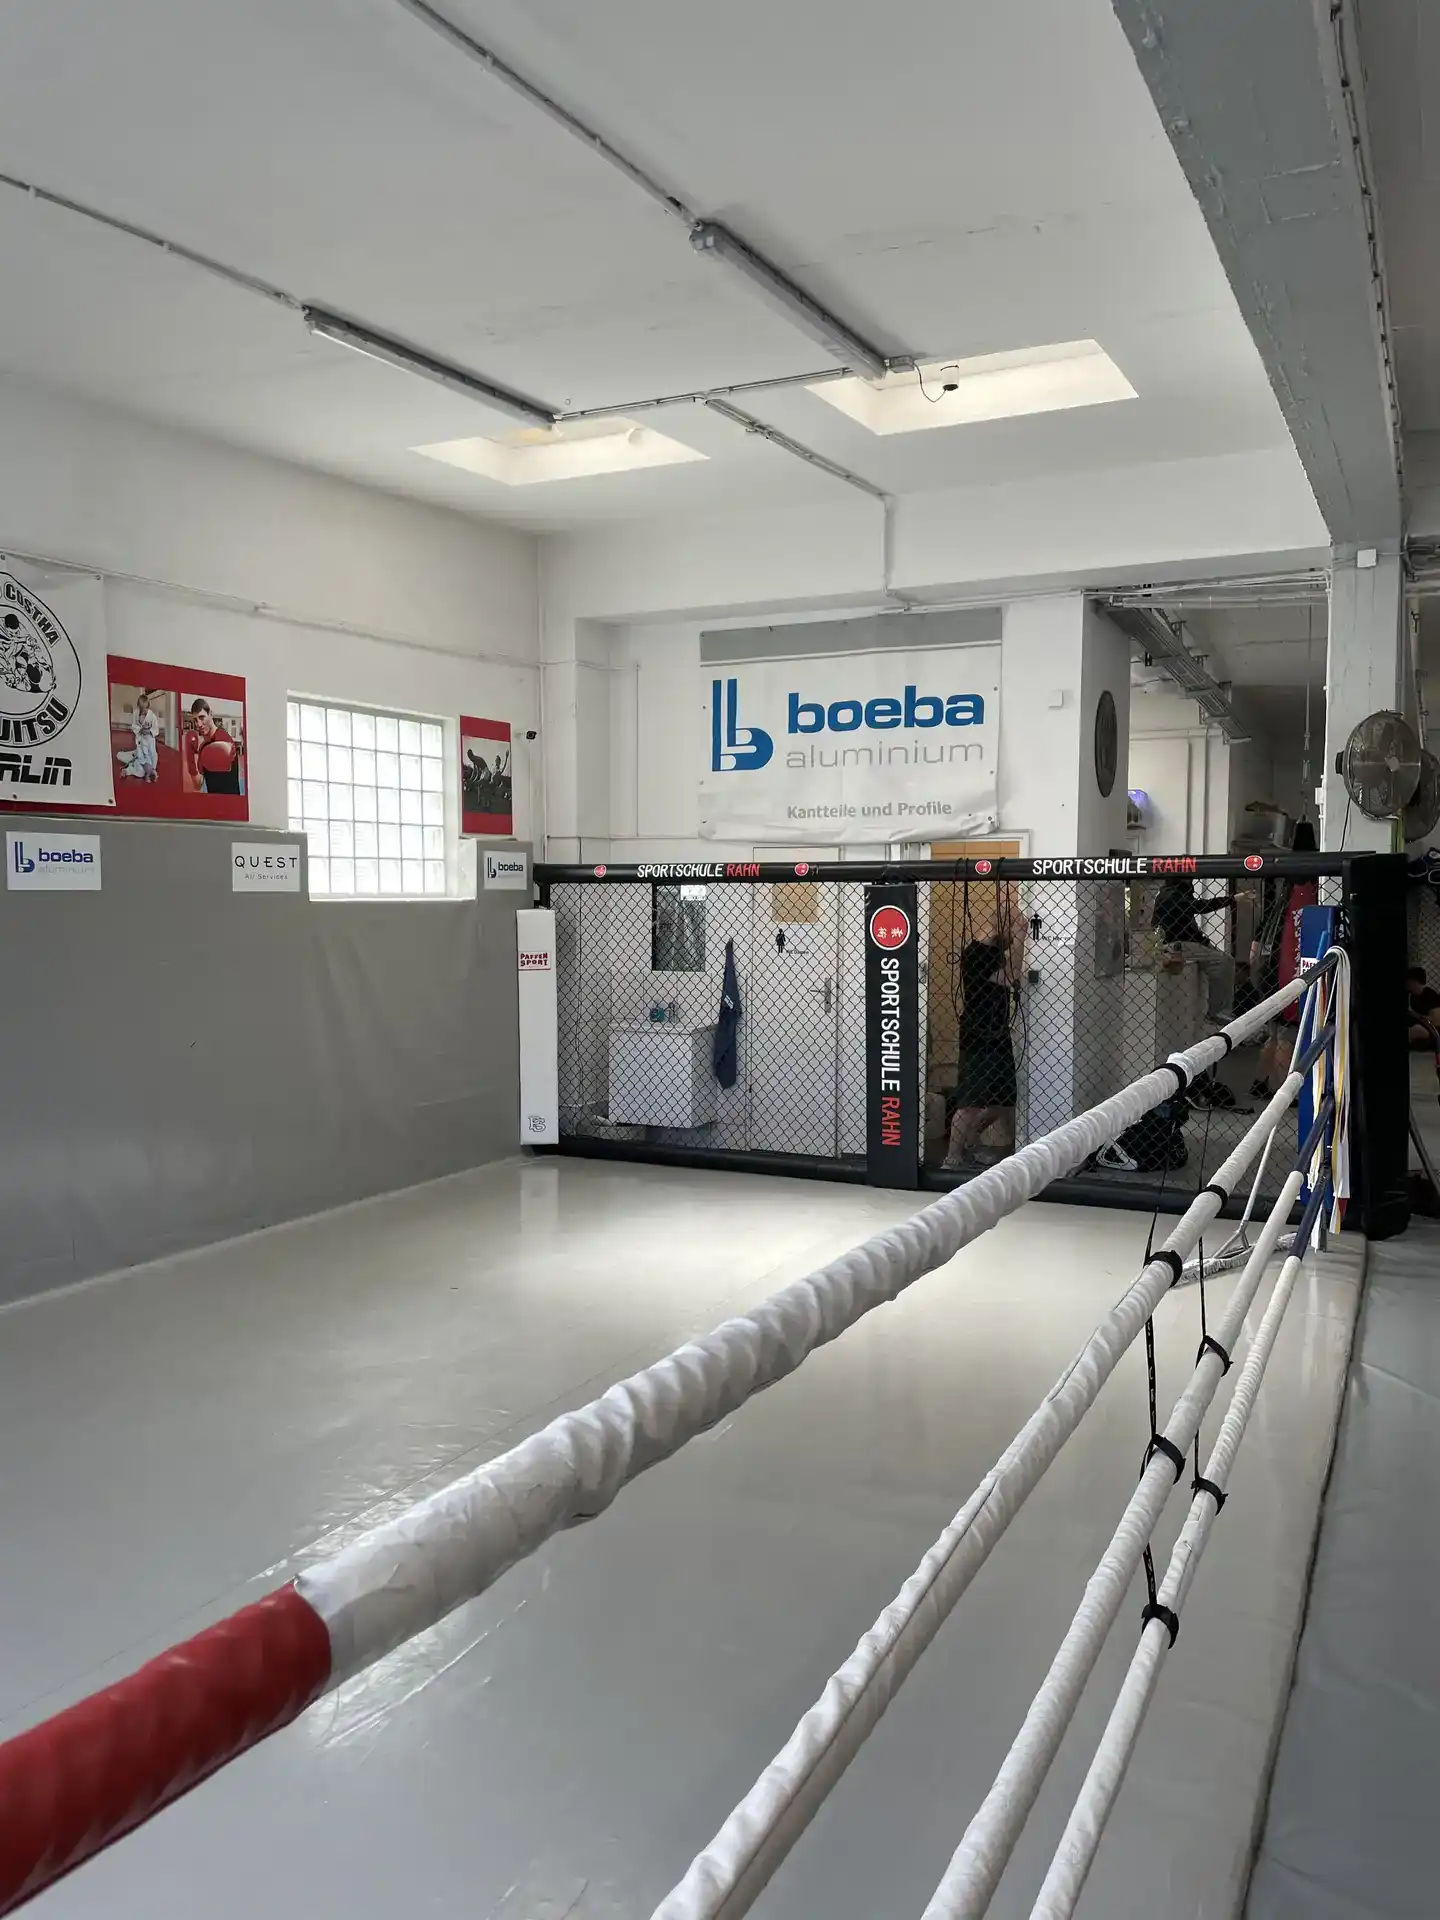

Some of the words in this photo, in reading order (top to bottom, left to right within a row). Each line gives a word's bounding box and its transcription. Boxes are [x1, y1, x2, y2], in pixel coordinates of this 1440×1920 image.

[788, 685, 985, 734] boeba
[786, 740, 984, 769] aluminium
[787, 804, 857, 820] Kantteile
[861, 802, 893, 818] und
[898, 801, 952, 816] Profile
[38, 847, 94, 863] boeba
[234, 855, 298, 869] QUEST
[497, 861, 524, 872] boeba
[637, 863, 724, 878] SPORTSCHULE
[726, 864, 761, 877] RAHN
[1032, 858, 1148, 875] SPORTSCHULE
[1152, 857, 1198, 873] RAHN
[881, 957, 900, 1092] SPORTSCHULE
[881, 1096, 901, 1146] RAHN
